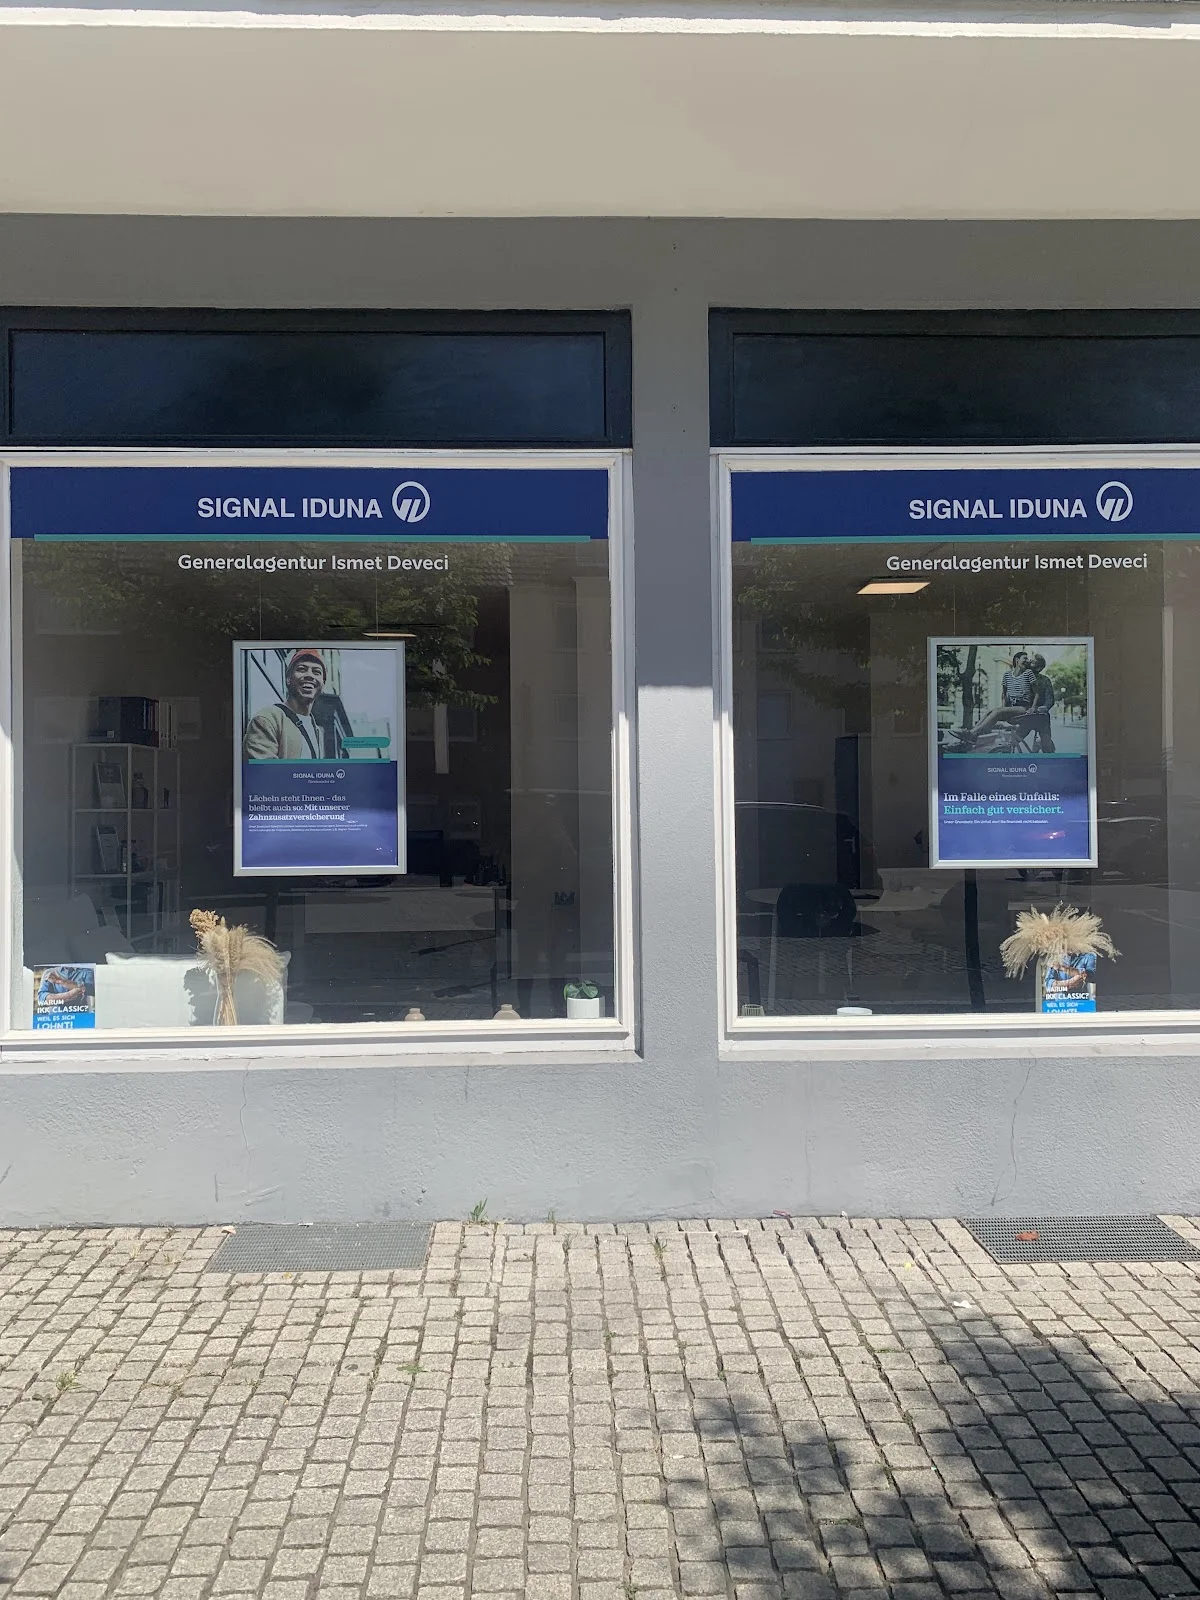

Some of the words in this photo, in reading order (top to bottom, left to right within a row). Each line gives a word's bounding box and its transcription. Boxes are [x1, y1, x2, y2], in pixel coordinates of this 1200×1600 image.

[197, 497, 295, 519] SIGNAL
[302, 498, 383, 519] IDUNA
[909, 499, 1003, 519] SIGNAL
[1009, 498, 1088, 519] IDUNA
[177, 553, 327, 573] Generalagentur
[332, 555, 382, 570] Ismet
[387, 554, 449, 570] Deveci
[886, 555, 1030, 573] Generalagentur
[1035, 554, 1084, 570] Ismet
[1088, 553, 1148, 569] Deveci
[943, 793, 959, 802] Im
[961, 792, 987, 801] Falle
[988, 793, 1017, 801] eines
[1019, 792, 1060, 801] Unfalls:
[248, 813, 345, 821] Zahnzusatzversicherung
[943, 805, 985, 815] Einfach
[987, 806, 1004, 816] gut
[1006, 804, 1064, 814] versichert.
